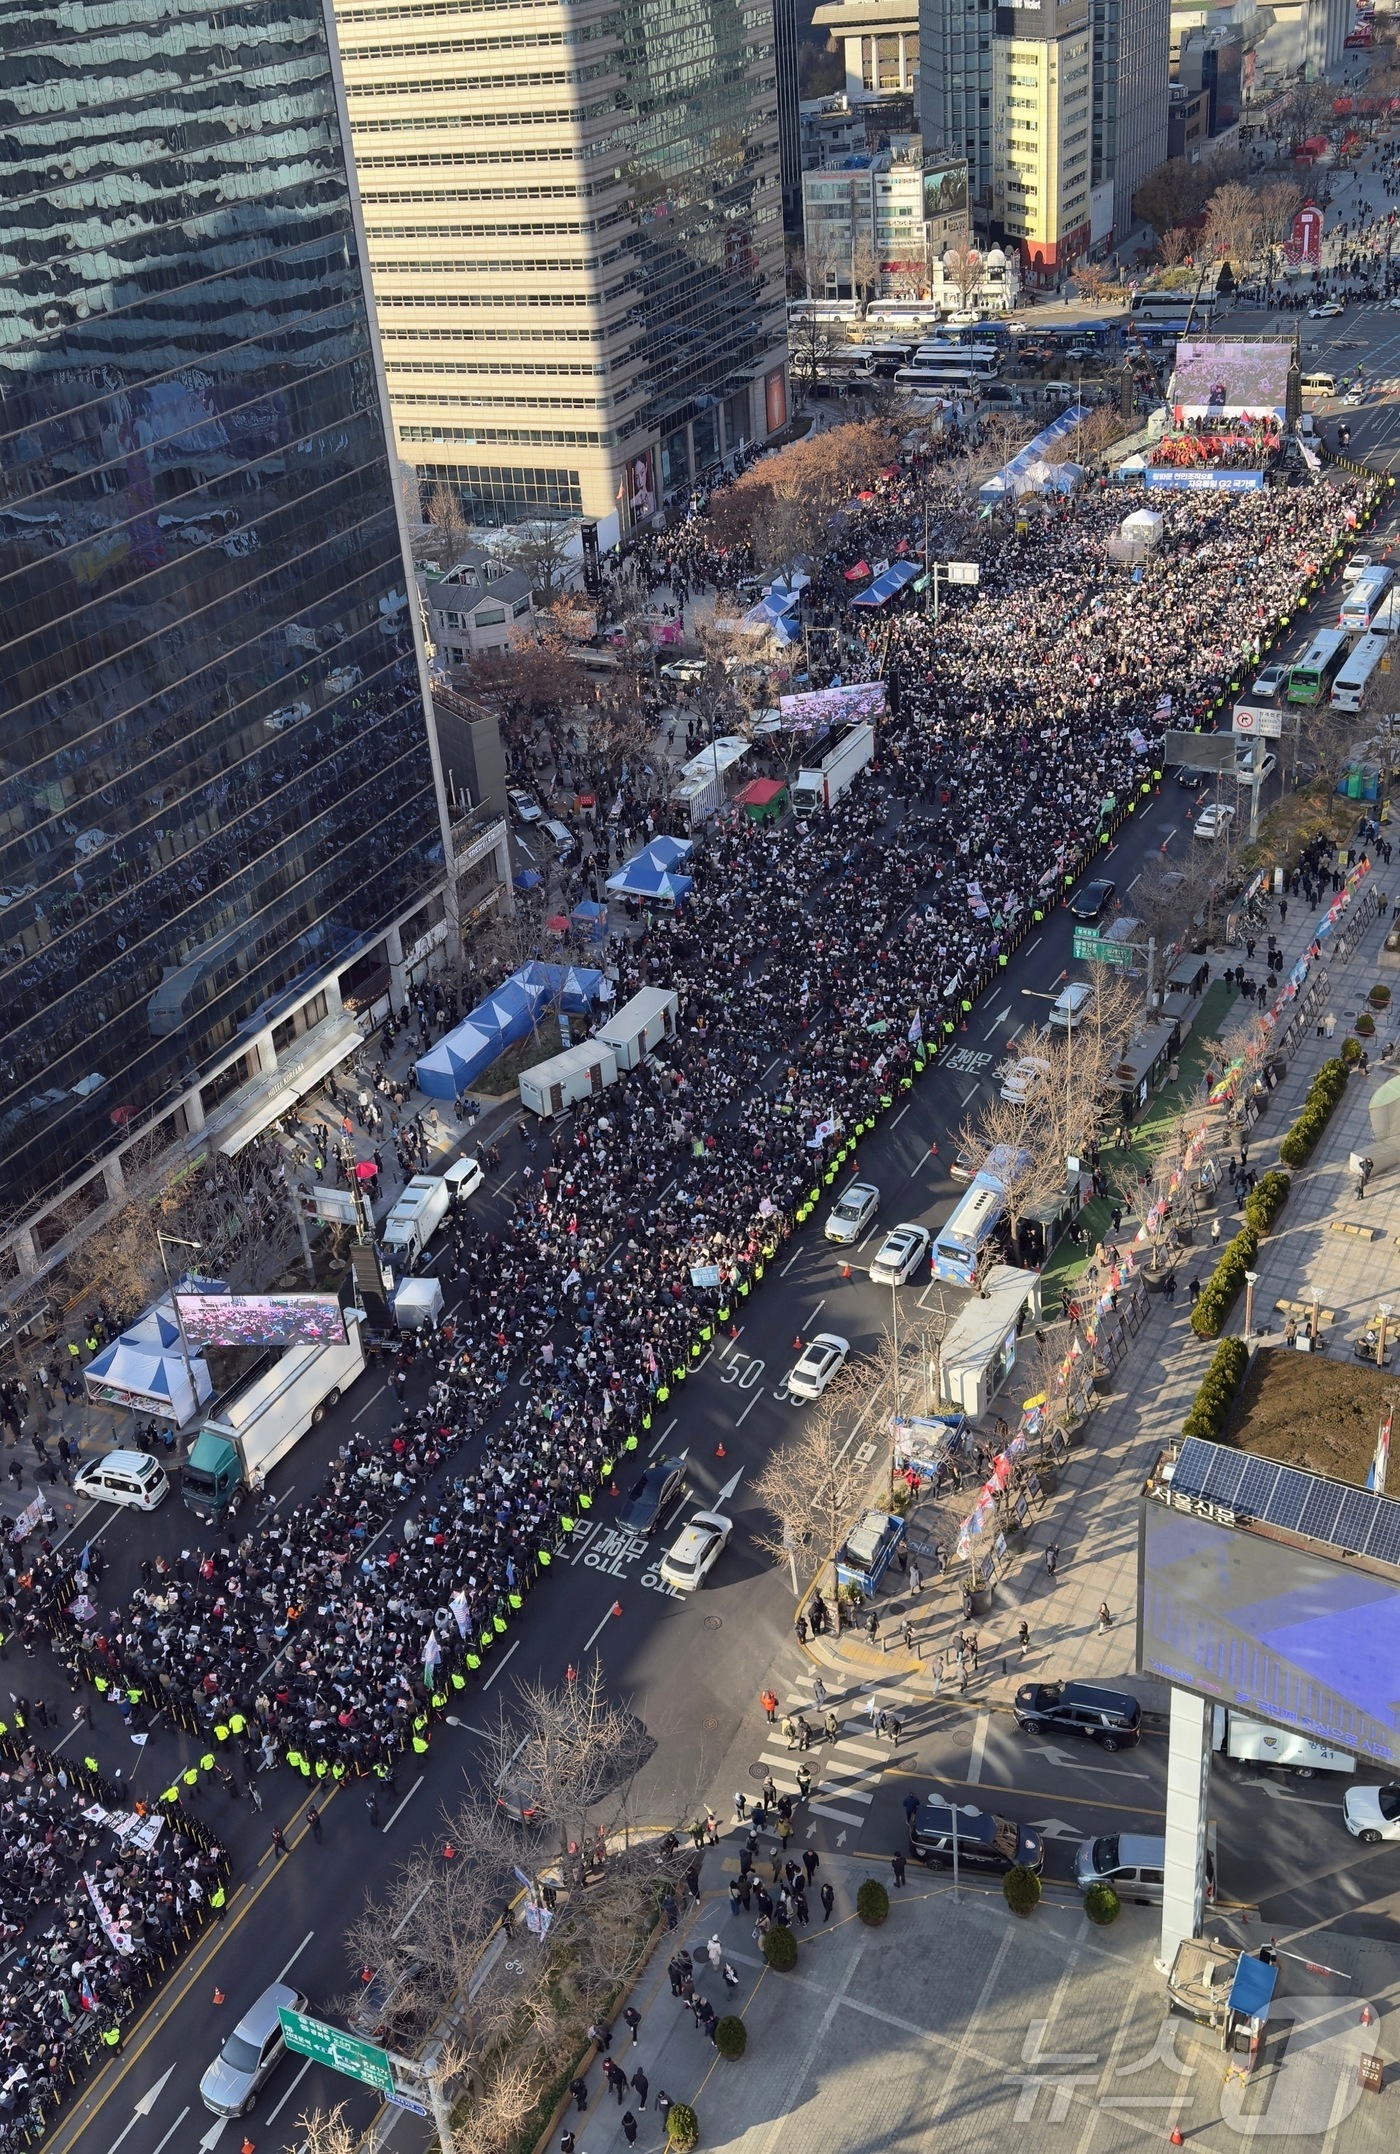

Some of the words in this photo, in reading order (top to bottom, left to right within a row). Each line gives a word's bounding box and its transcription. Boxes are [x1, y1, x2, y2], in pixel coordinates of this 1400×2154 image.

[1188, 480, 1218, 488] 자유통일
[1219, 480, 1232, 488] G2
[1233, 480, 1256, 488] 국가로
[946, 1048, 993, 1075] 광화문
[267, 1083, 283, 1099] HOTEL
[283, 1062, 305, 1085] KOREANA
[720, 1353, 766, 1389] 50
[1149, 1485, 1237, 1528] 서울신문
[583, 1527, 650, 1580] 광화문
[1301, 1715, 1360, 1748] 진심으로
[1320, 1751, 1334, 1760] 41
